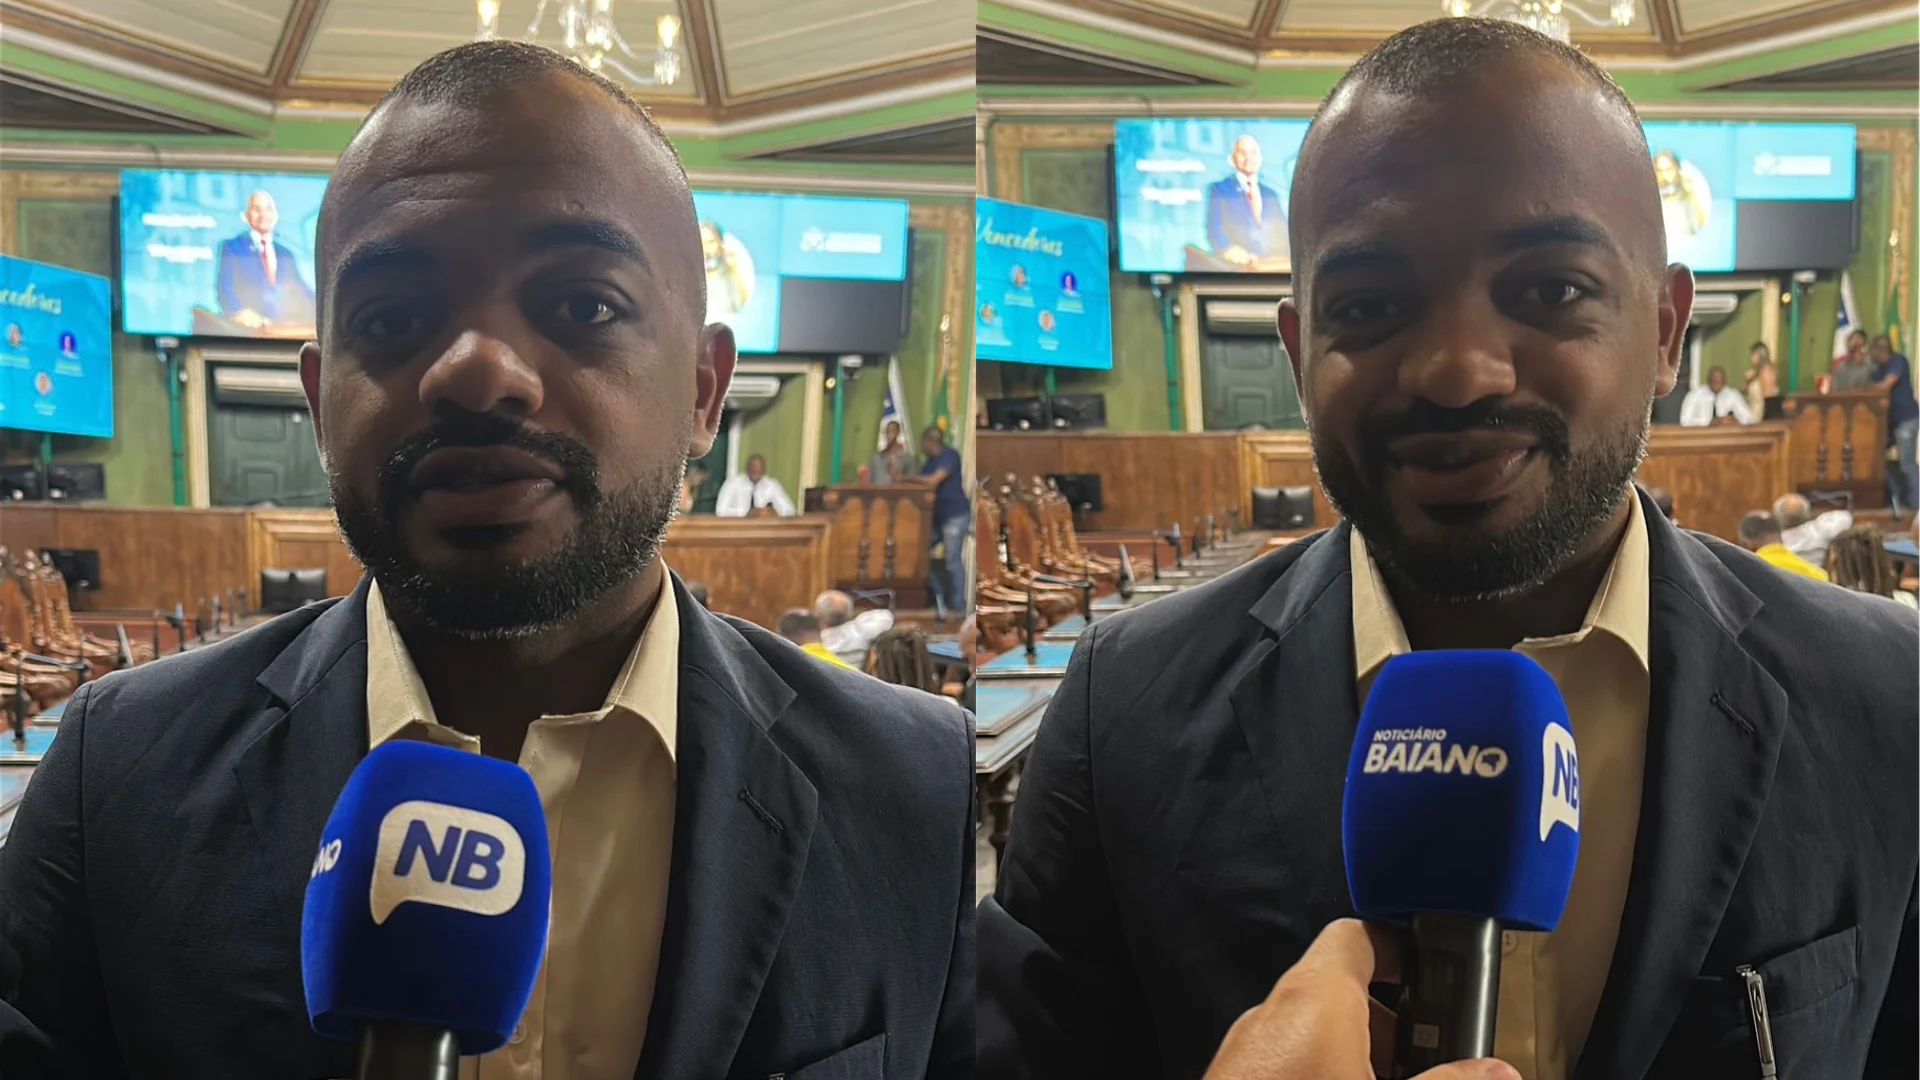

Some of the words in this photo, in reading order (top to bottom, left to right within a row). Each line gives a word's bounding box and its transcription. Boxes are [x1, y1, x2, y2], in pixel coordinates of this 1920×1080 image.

[1373, 726, 1447, 742] NOTICIÁRIO
[1363, 742, 1508, 778] BAIANO
[393, 818, 505, 891] NB
